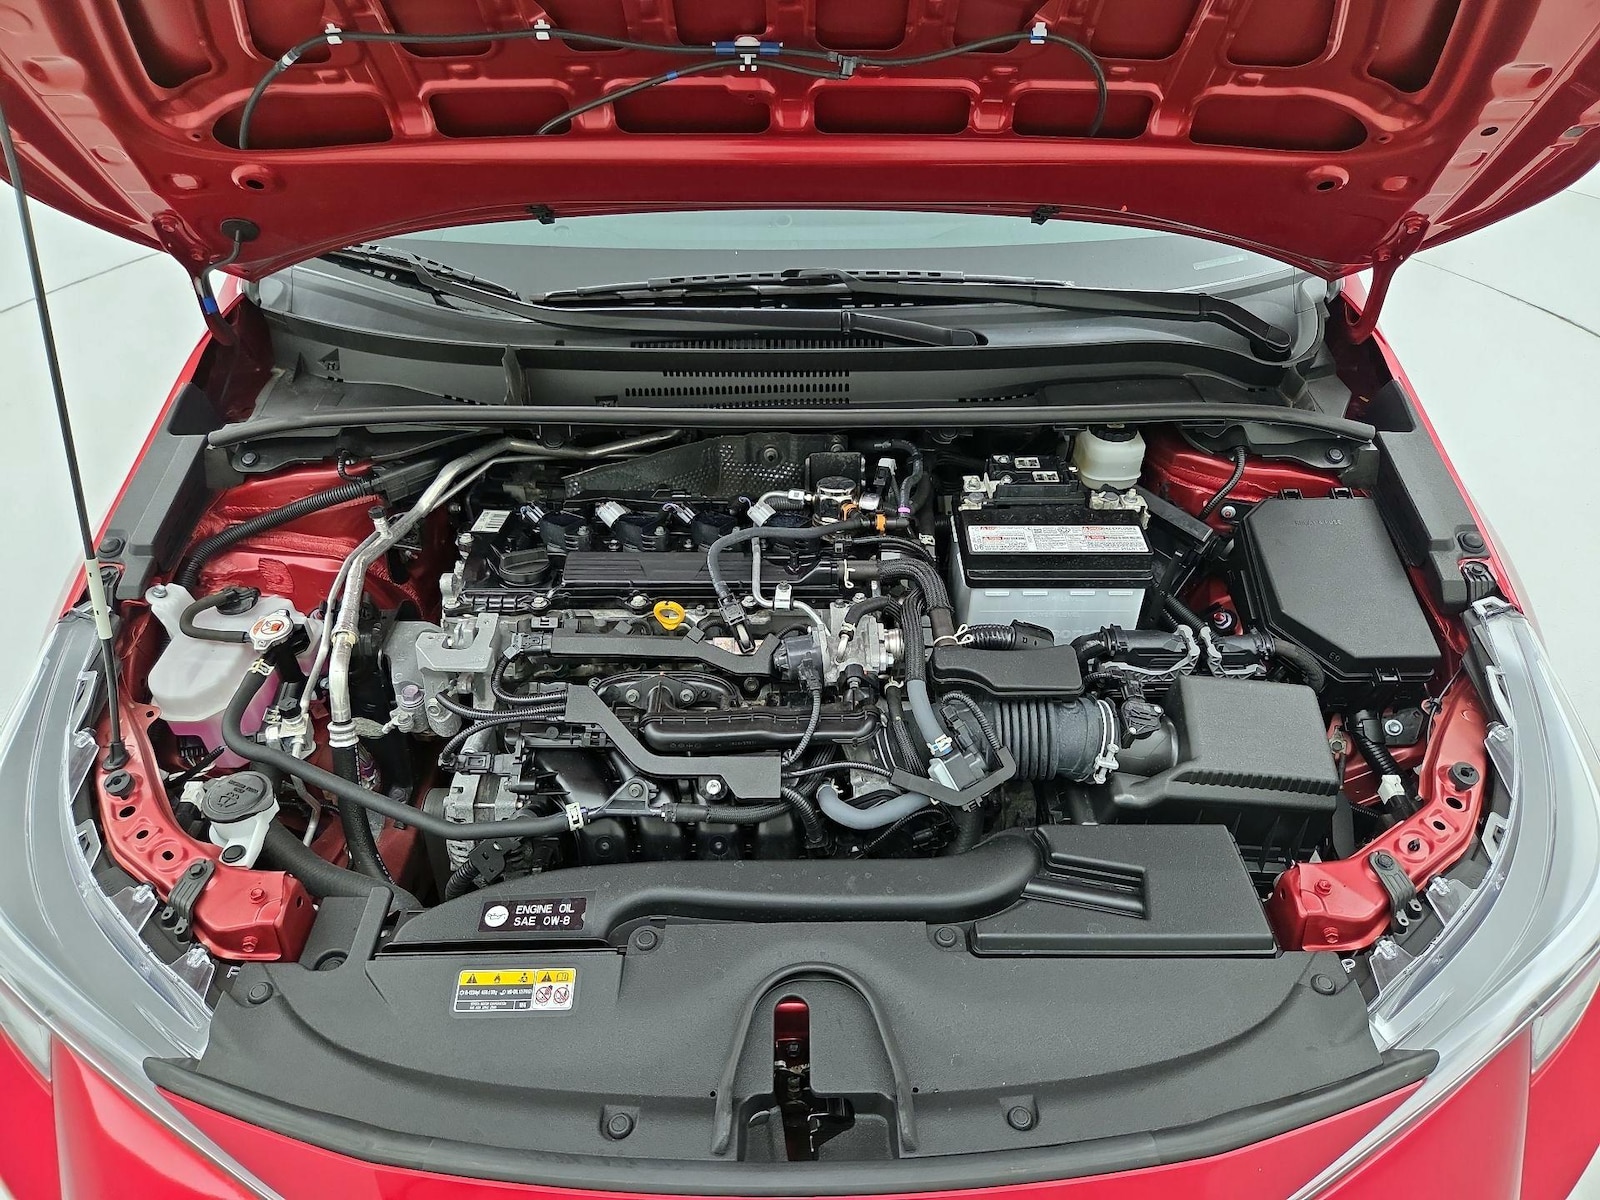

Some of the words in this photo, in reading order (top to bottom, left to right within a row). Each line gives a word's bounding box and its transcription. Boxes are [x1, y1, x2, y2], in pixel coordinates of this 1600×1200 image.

[515, 904, 553, 914] ENGINE
[558, 903, 575, 913] OIL
[513, 916, 537, 926] SAE
[542, 915, 571, 925] 0W-8
